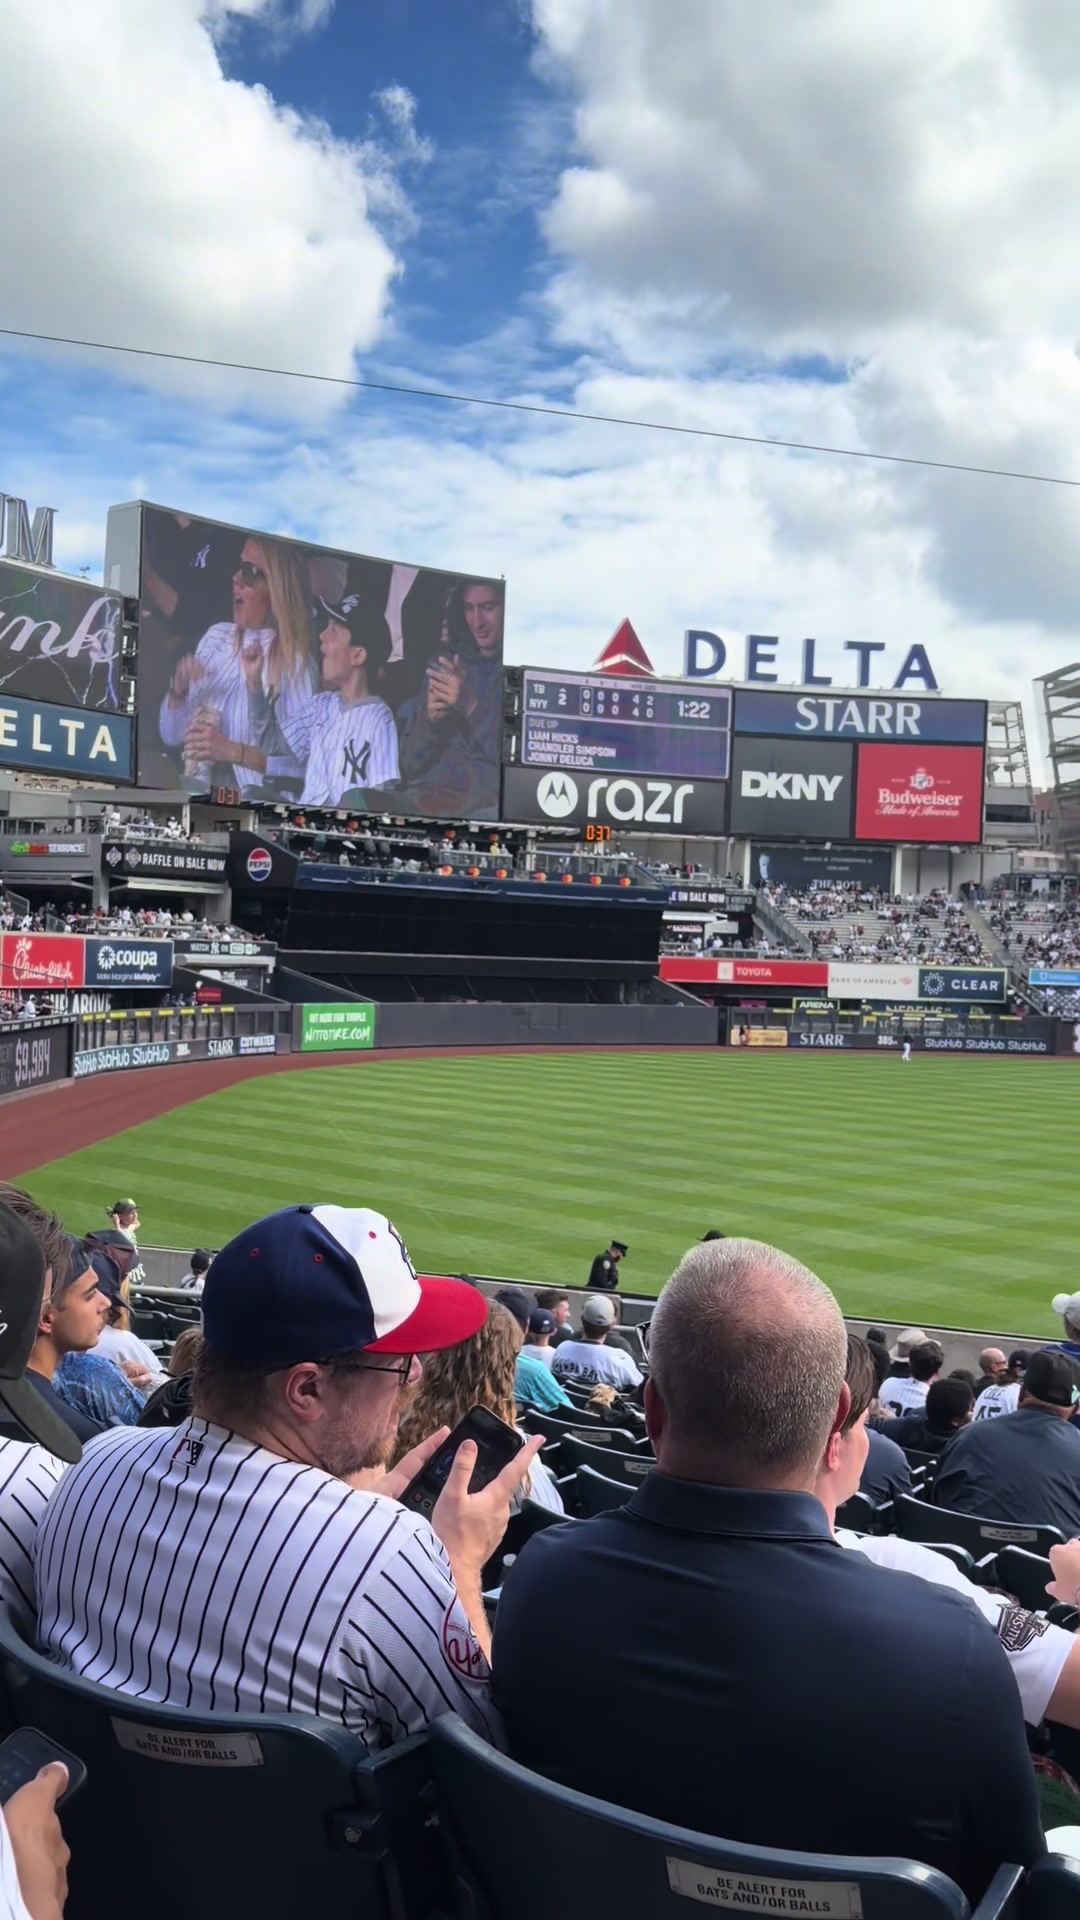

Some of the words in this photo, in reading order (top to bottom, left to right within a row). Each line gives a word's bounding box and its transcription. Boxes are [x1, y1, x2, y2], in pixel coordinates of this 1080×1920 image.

[684, 630, 938, 690] DELTA
[533, 683, 546, 694] TB
[583, 689, 591, 699] 0
[597, 691, 605, 701] 0
[558, 692, 567, 705] 2
[612, 692, 619, 702] 0
[582, 702, 590, 712] 0
[597, 704, 604, 714] 0
[611, 705, 619, 715] 0
[677, 700, 711, 719] 1:22
[795, 697, 922, 735] STARR
[528, 731, 550, 741] LIAM
[528, 741, 574, 754] CHANDLER
[575, 746, 616, 758] SIMPSON
[527, 752, 558, 763] JONNY
[559, 755, 594, 766] DELUCA
[741, 770, 844, 801] DKNY
[587, 778, 694, 824] razr
[878, 788, 963, 806] Budweiser
[586, 825, 611, 841] 0:37
[142, 852, 171, 867] RAFFLE
[174, 856, 184, 868] ON
[186, 858, 206, 869] SALE
[207, 859, 225, 871] NOW
[117, 950, 157, 970] coupa
[736, 967, 772, 977] TOYOTA
[951, 979, 999, 991] CLEAR
[799, 1001, 835, 1010] ARENA
[207, 1039, 234, 1056] STARR
[800, 1033, 844, 1046] STARR
[925, 1038, 963, 1049] StubHub
[965, 1039, 1005, 1050] StubHub
[1007, 1040, 1047, 1051] StubHub
[15, 1038, 51, 1087] $9,984
[98, 1049, 130, 1070] StubHub
[132, 1046, 170, 1066] StubHub
[147, 1732, 160, 1743] BE
[163, 1736, 193, 1747] ALERT
[195, 1739, 216, 1749] FOR
[136, 1738, 159, 1751] BATS
[161, 1745, 202, 1758] AND/OR
[204, 1750, 238, 1760] BALLS
[717, 1877, 734, 1889] BE
[738, 1882, 777, 1895] ALERT
[781, 1887, 806, 1899] FOR
[698, 1884, 729, 1900] BATS
[733, 1892, 787, 1909] AND/OR
[790, 1901, 831, 1912] BALLS
